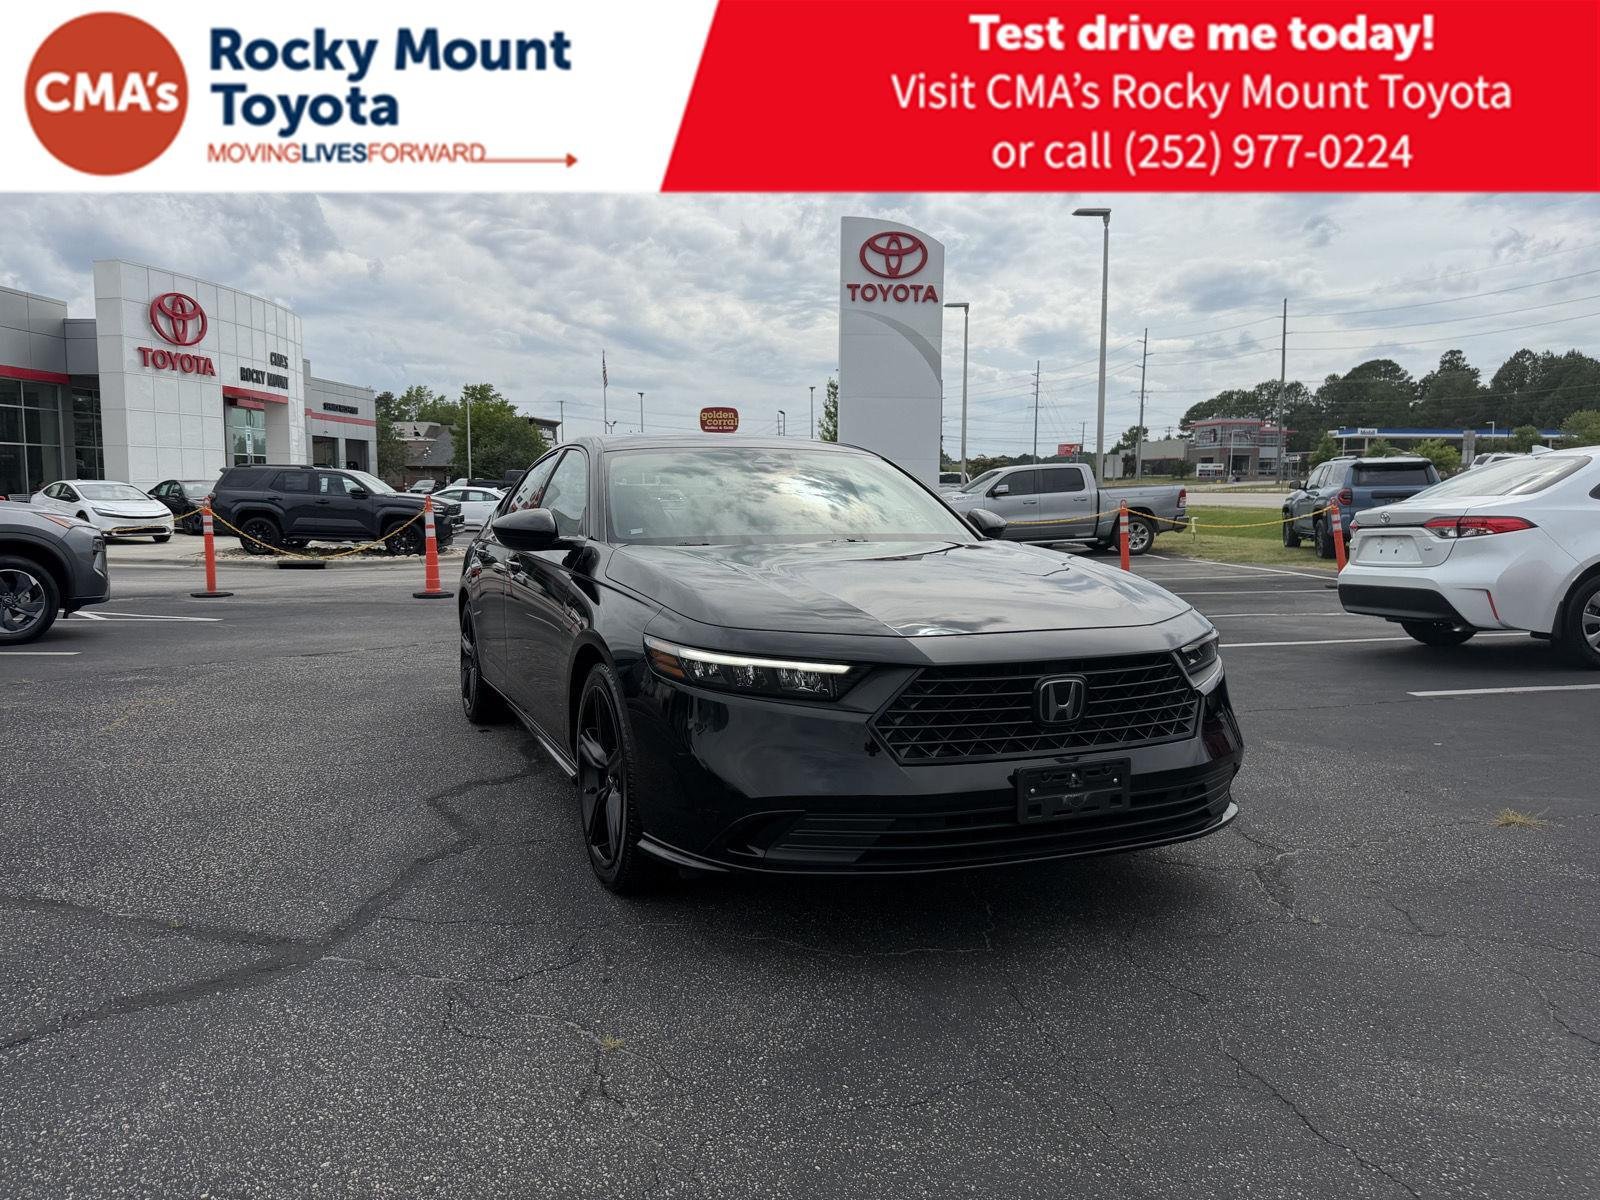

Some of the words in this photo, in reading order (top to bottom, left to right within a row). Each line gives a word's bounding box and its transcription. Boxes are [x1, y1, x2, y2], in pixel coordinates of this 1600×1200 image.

[846, 283, 939, 304] TOYOTA
[137, 346, 217, 377] TOYOTA
[701, 410, 734, 420] golden
